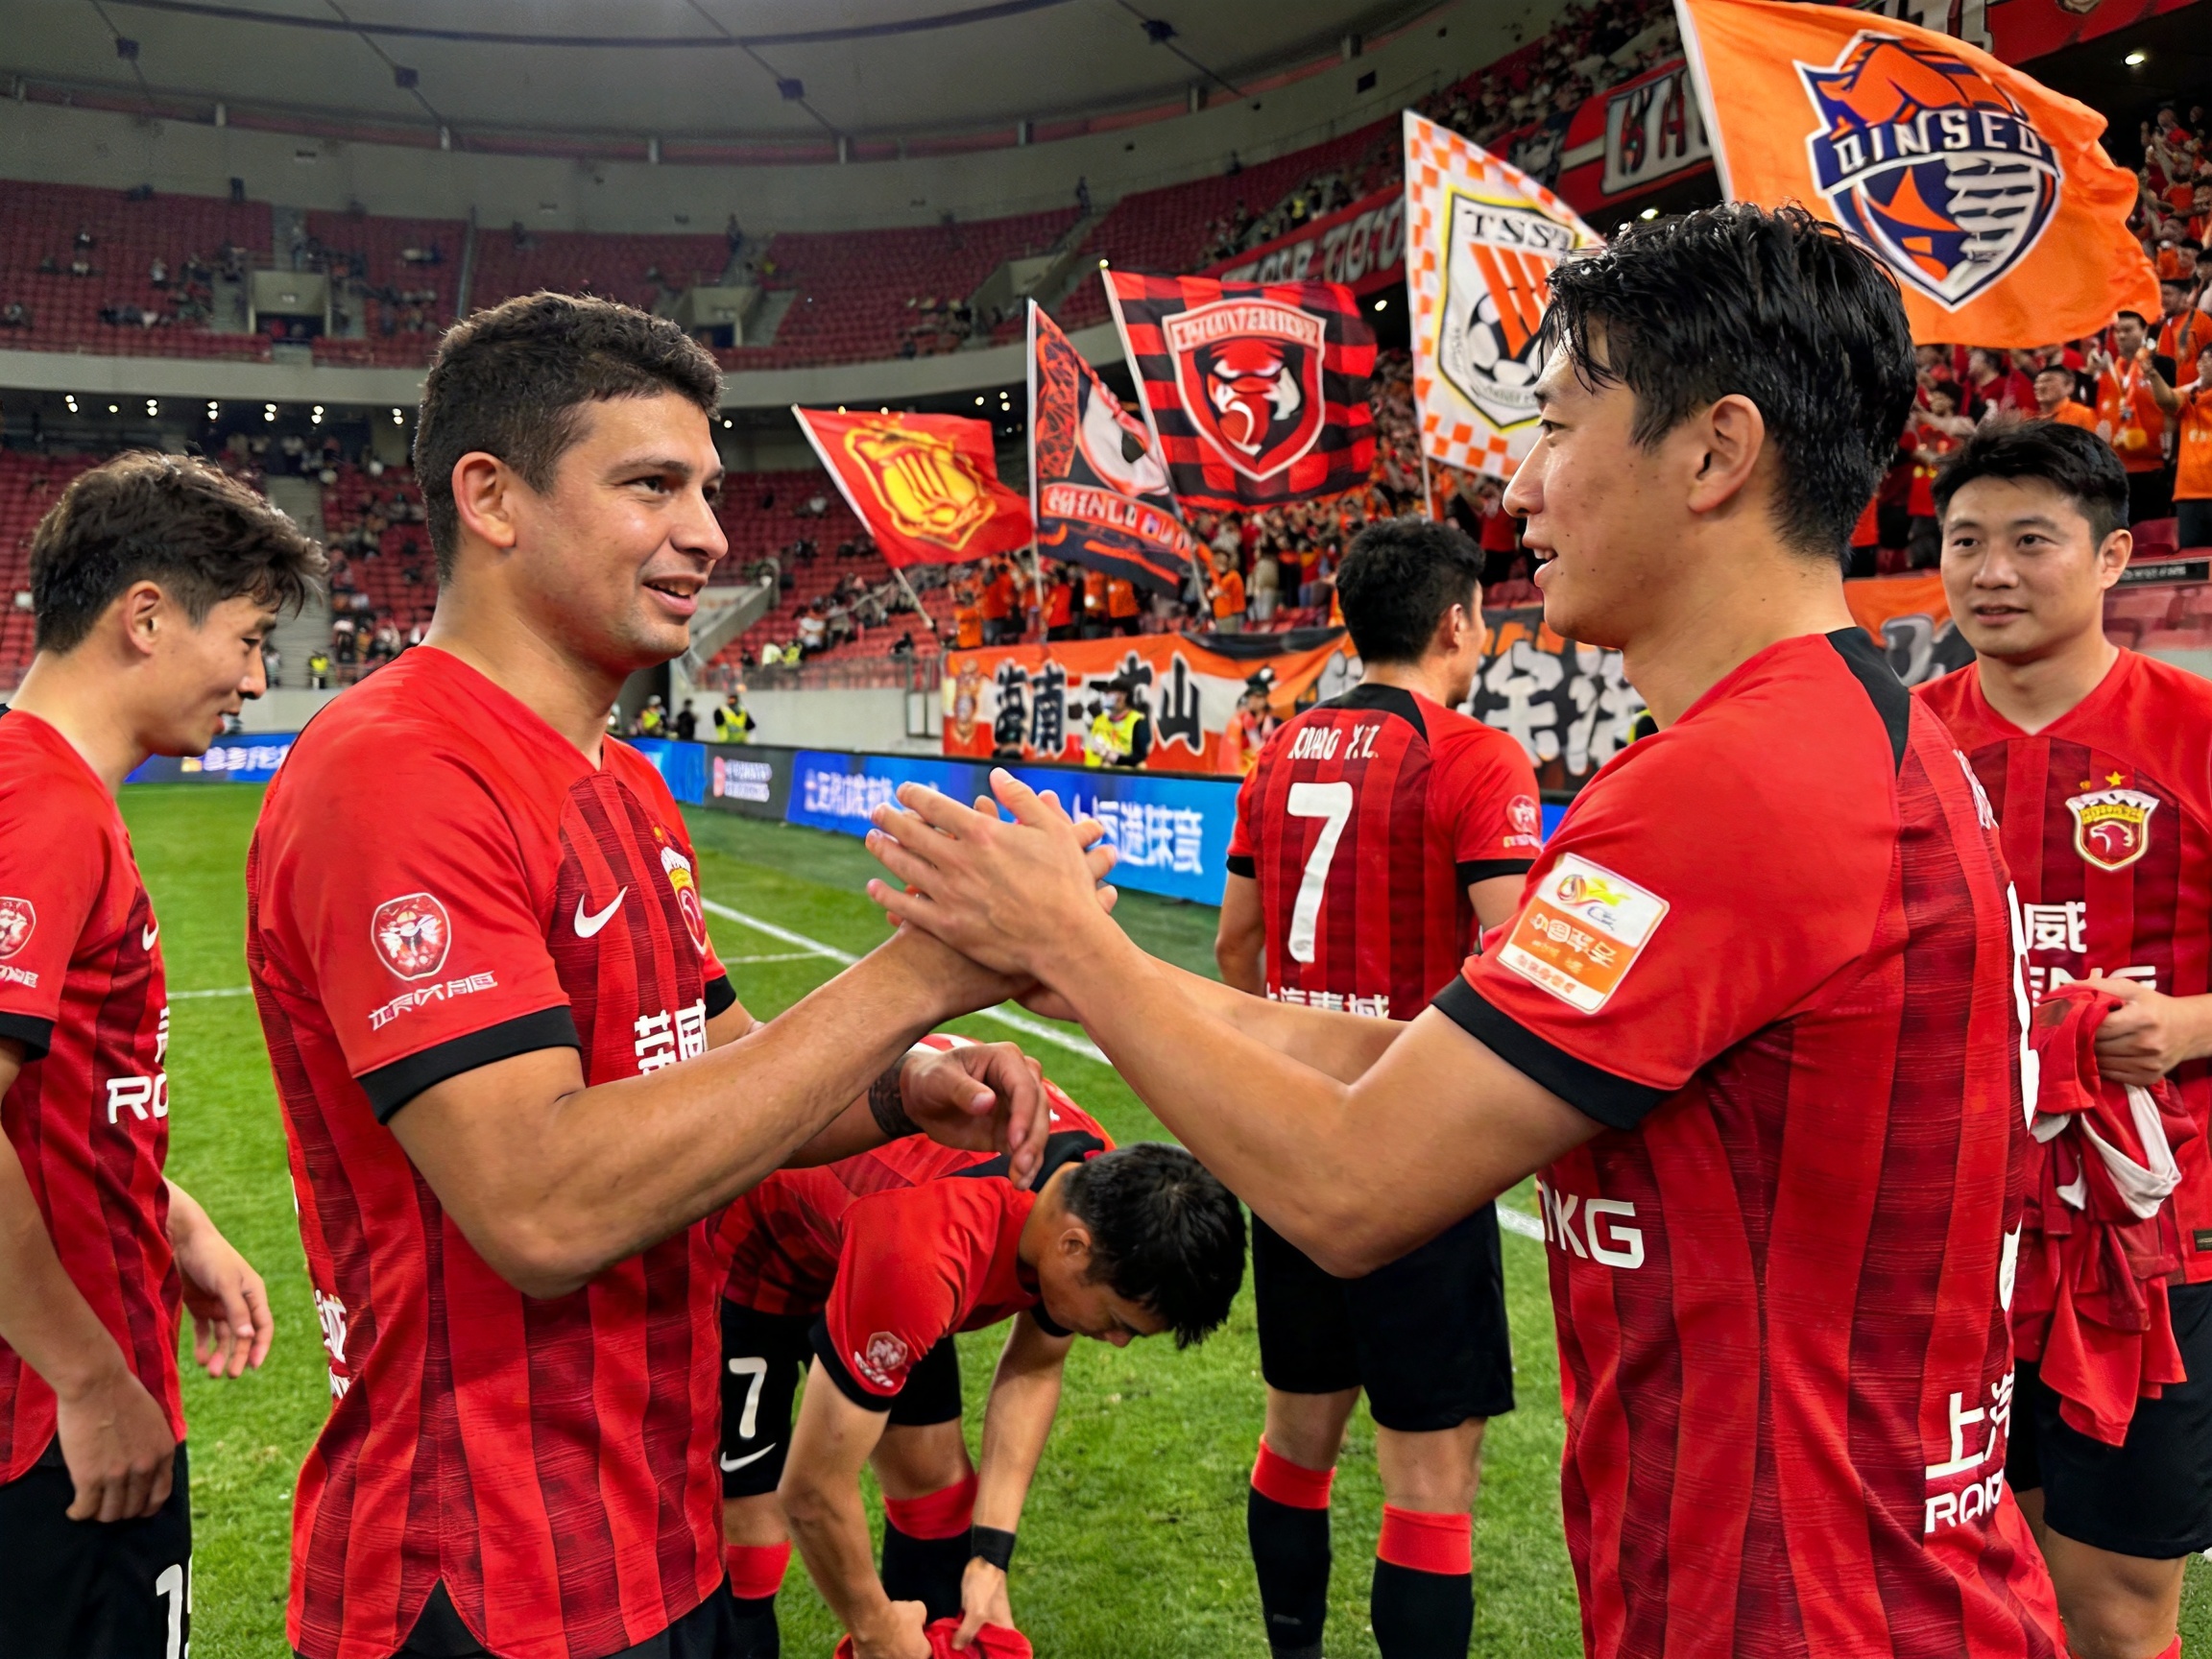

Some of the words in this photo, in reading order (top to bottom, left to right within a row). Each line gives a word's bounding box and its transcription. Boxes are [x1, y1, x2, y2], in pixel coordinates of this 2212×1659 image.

[1286, 781, 1354, 963] 7
[728, 1357, 767, 1439] 7
[156, 1553, 192, 1659] 1
